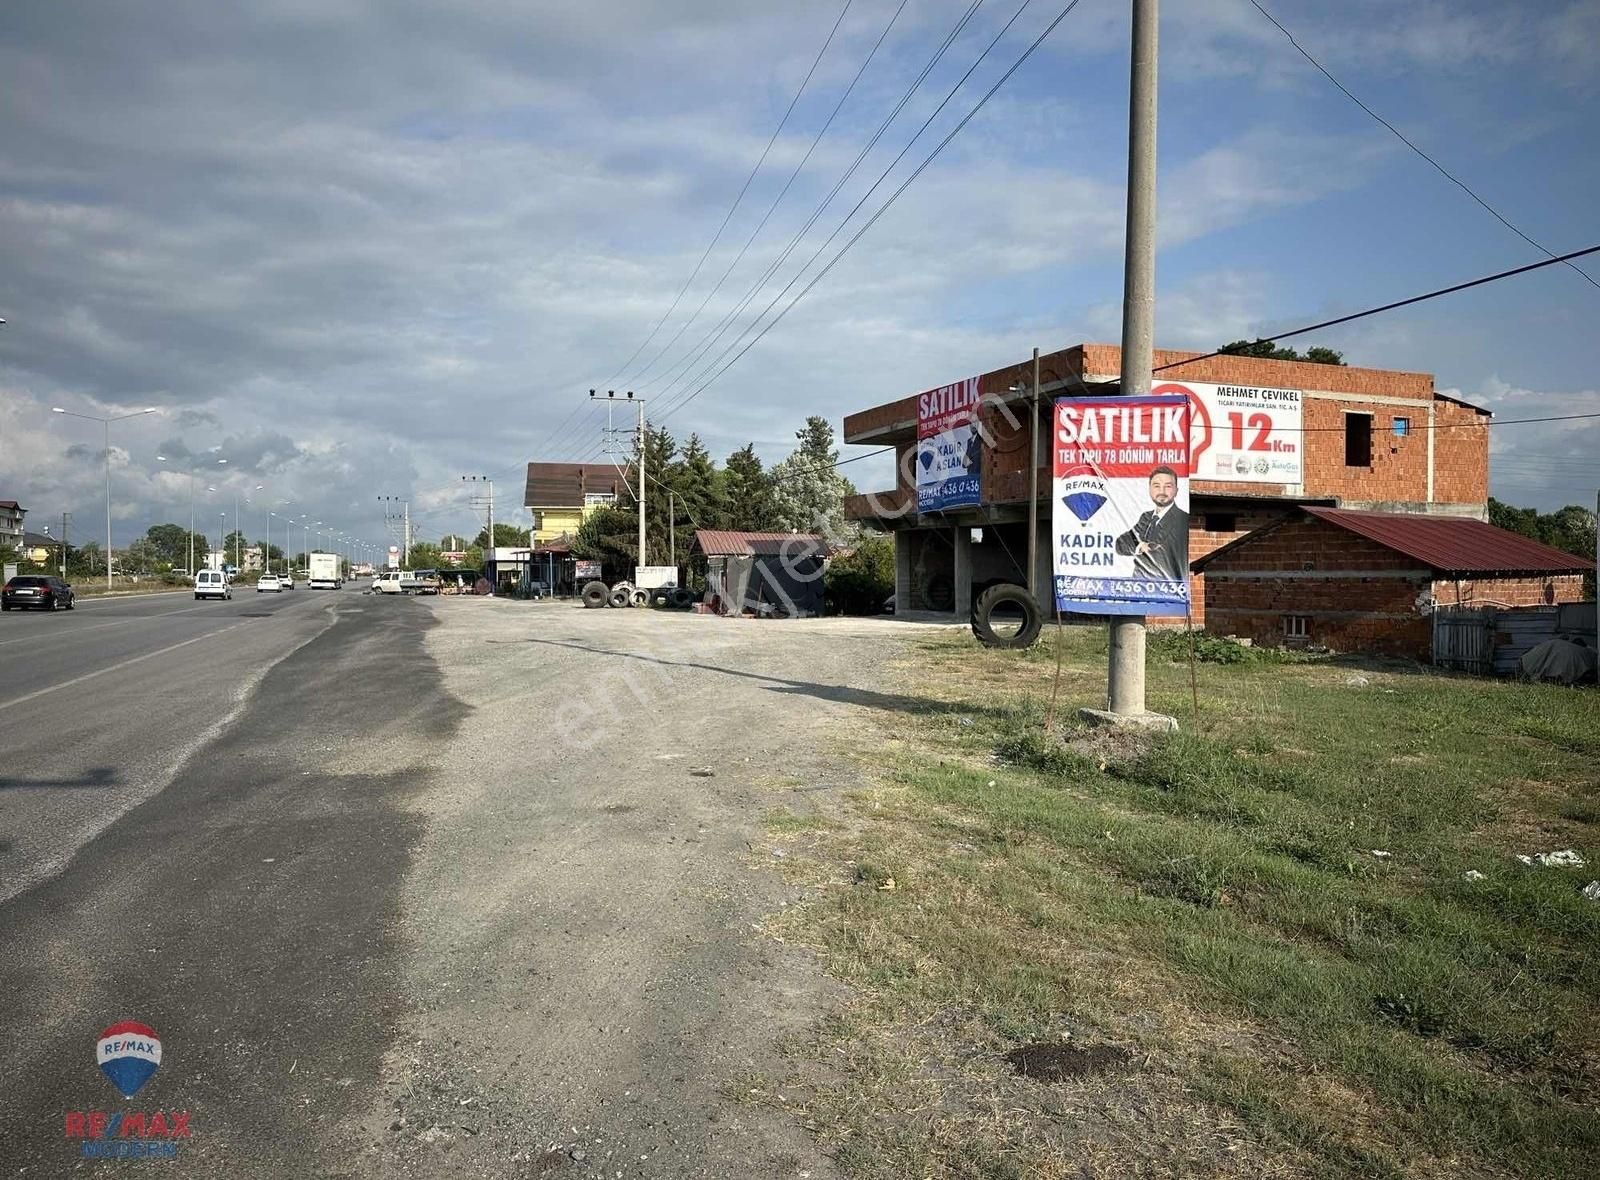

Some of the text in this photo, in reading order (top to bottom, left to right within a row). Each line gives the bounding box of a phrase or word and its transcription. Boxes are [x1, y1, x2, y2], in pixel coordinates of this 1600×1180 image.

[920, 377, 980, 419] SATILIK
[1217, 387, 1258, 399] MEHMET
[1059, 407, 1185, 443] SATILIK
[1228, 412, 1272, 451] 12
[1274, 440, 1295, 452] Km
[1059, 446, 1186, 464] TEK TAPU 78 DÖNÜM TARLA
[936, 457, 962, 472] ASLAN
[1065, 480, 1105, 491] RE/MAX
[1060, 532, 1114, 548] KADİR
[1060, 551, 1114, 566] ASLAN
[1057, 578, 1104, 591] RE/MAX
[1116, 582, 1142, 592] 436
[1160, 582, 1186, 594] 436
